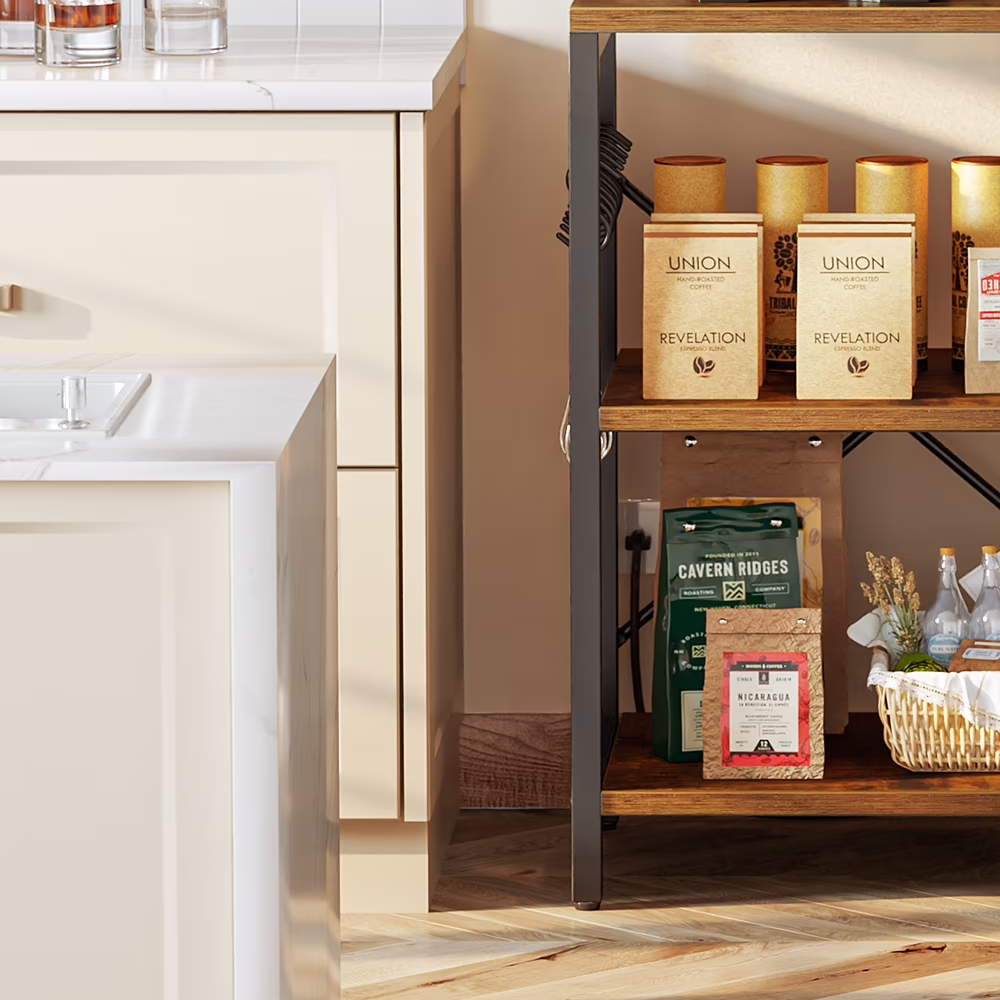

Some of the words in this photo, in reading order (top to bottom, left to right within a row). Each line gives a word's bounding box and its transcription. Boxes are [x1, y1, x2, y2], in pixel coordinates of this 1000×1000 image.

[669, 256, 730, 270] UNION
[823, 256, 884, 270] UNION
[660, 332, 746, 344] REVELATION
[814, 332, 900, 344] REVELATION
[678, 562, 733, 579] CAVERN
[738, 560, 789, 576] RIDGES
